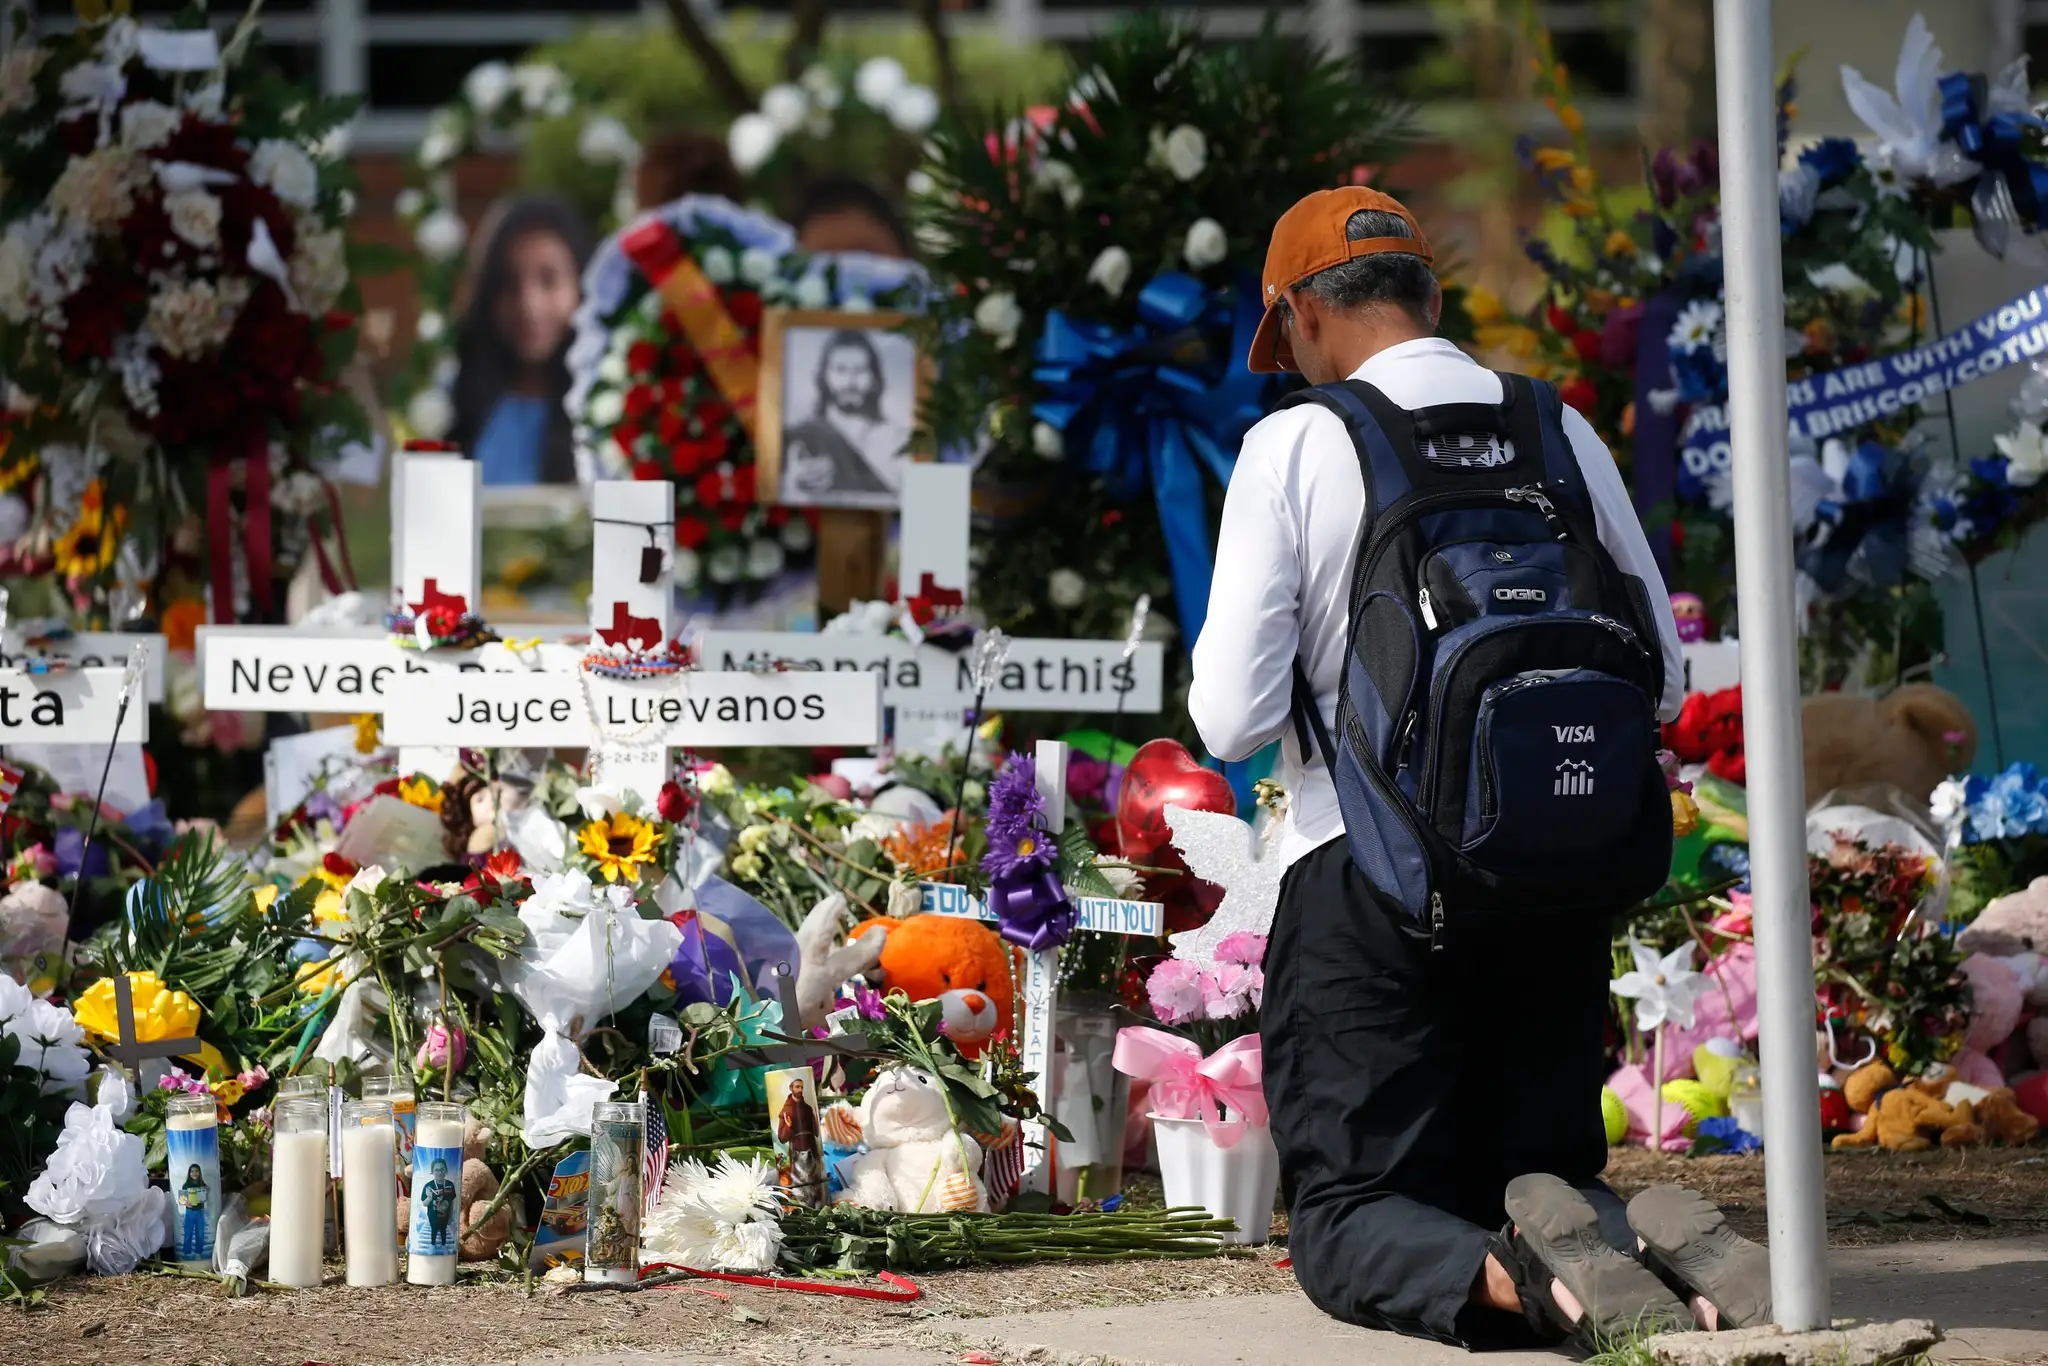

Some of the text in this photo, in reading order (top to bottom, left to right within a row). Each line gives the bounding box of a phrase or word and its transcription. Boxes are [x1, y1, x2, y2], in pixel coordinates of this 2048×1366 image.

[1823, 361, 1886, 400] ARE
[1891, 328, 1974, 376] WITH
[1975, 290, 2041, 341] YOU
[1495, 588, 1546, 601] OGIO
[448, 693, 825, 731] Jayce Luevanos
[1551, 725, 1596, 743] VISA
[920, 884, 970, 914] GOD
[1077, 897, 1118, 931] WITH
[1123, 901, 1155, 934] YOU
